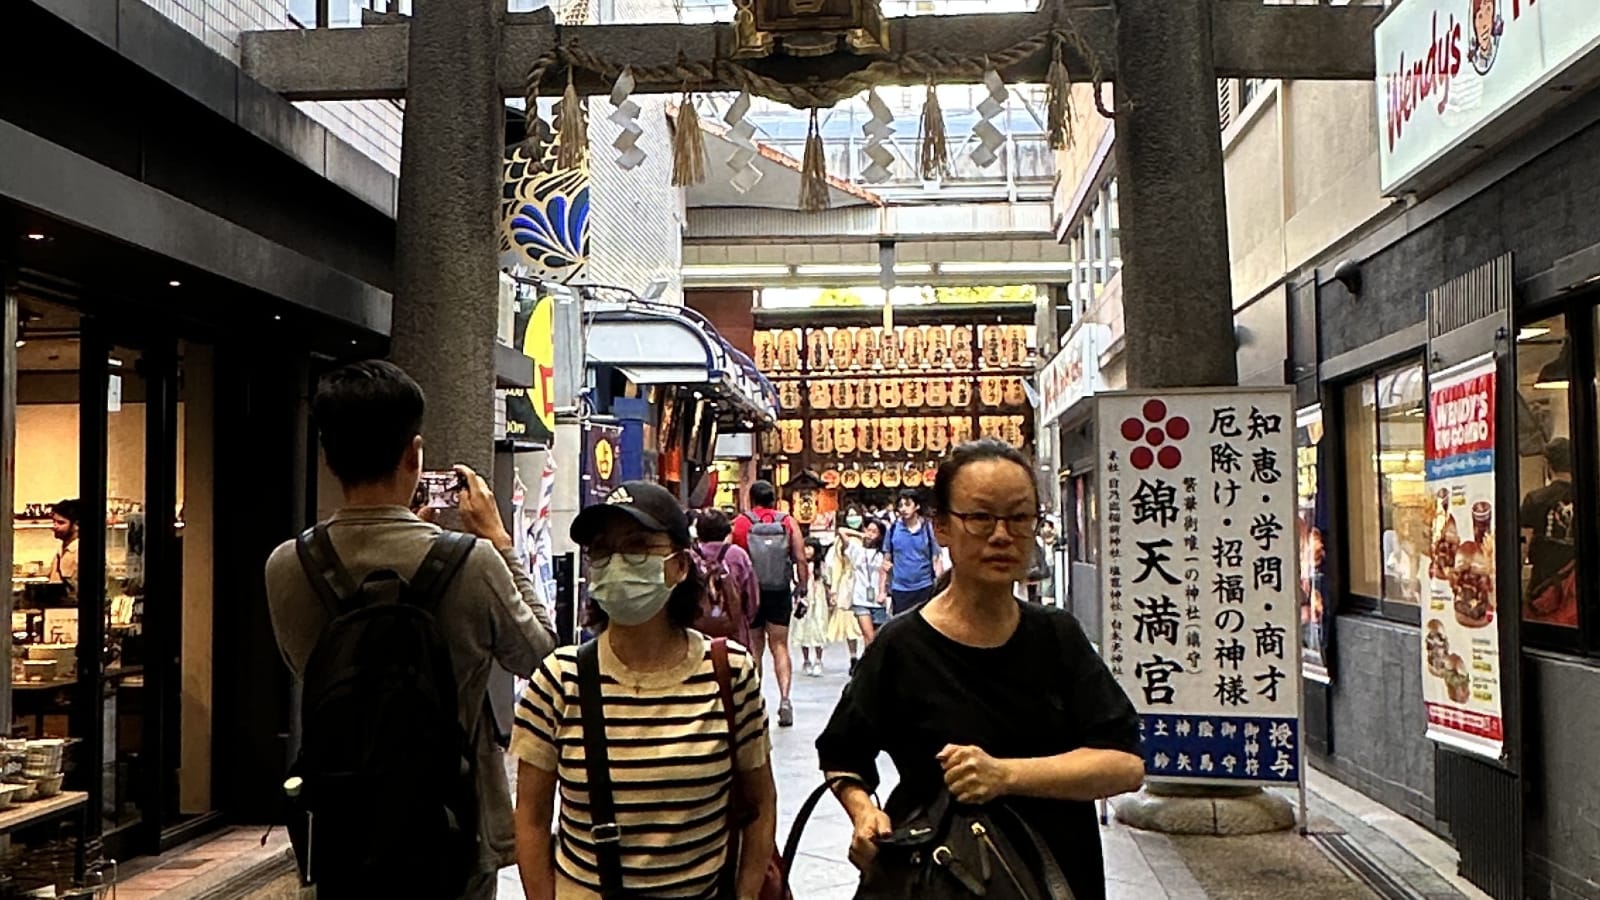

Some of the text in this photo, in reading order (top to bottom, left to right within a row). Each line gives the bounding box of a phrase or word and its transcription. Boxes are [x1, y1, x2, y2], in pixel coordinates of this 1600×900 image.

[1387, 10, 1461, 153] Wendy's
[1437, 392, 1488, 427] WENDY'S
[1130, 478, 1184, 705] 錦天満宮
[1209, 407, 1249, 706] 厄除け・招福の神様
[1247, 406, 1286, 701] 知恵・学問・商才
[1269, 721, 1294, 777] 授与
